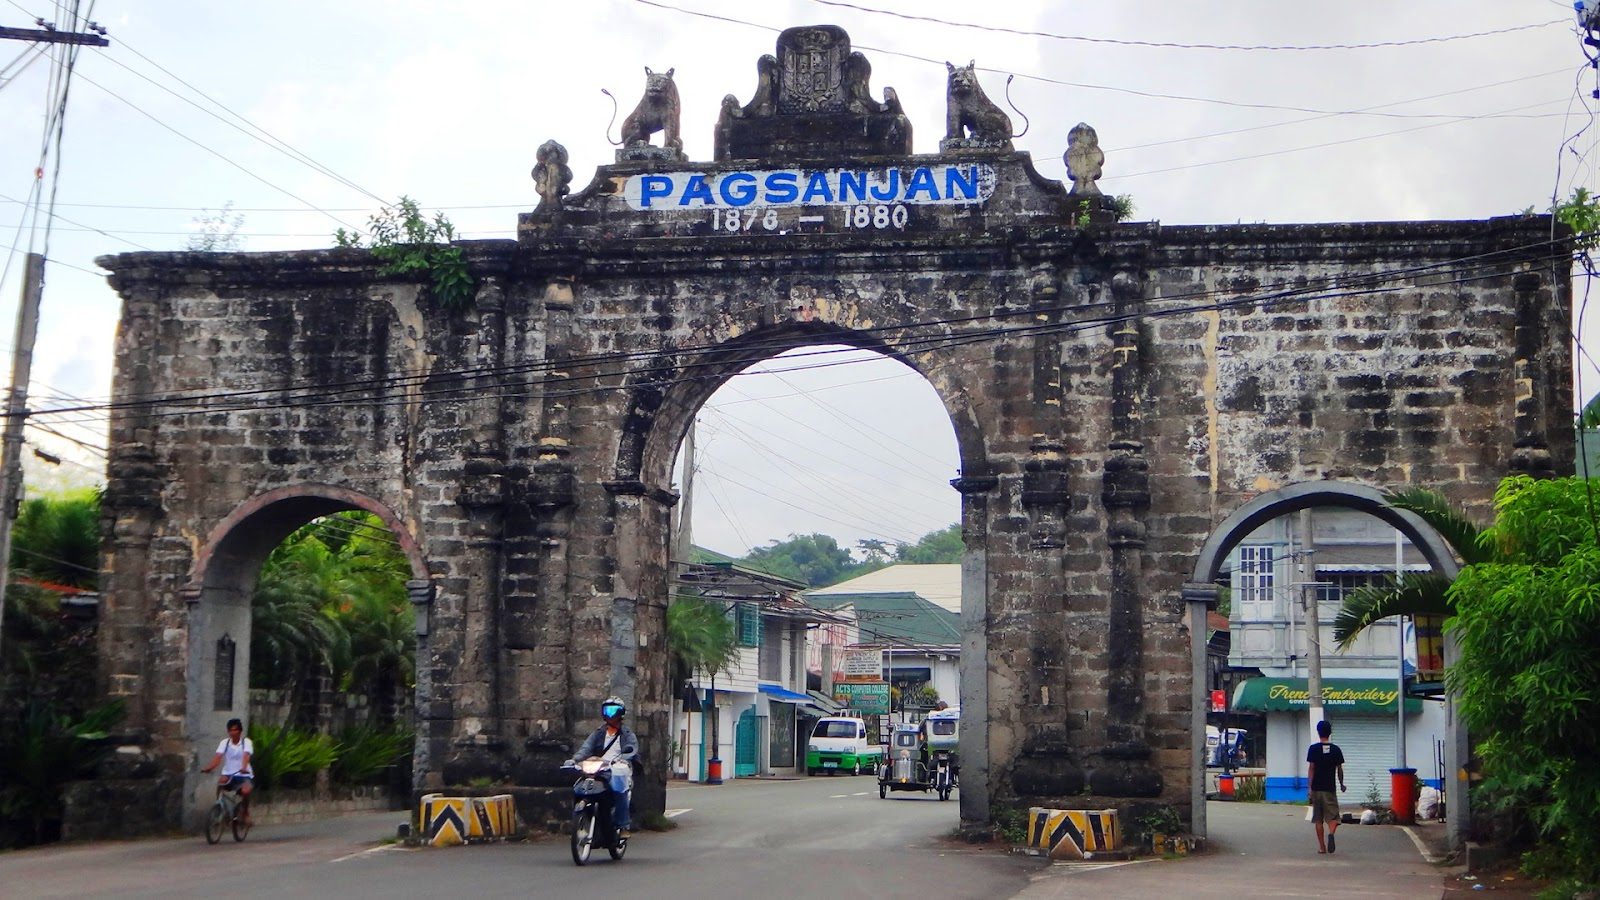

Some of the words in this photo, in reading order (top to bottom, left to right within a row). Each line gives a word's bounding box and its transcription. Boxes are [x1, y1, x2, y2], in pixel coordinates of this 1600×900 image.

[640, 166, 978, 207] PAGSANJAN
[842, 204, 908, 230] 1880
[835, 684, 851, 694] ACTS
[851, 684, 872, 695] COMPUTER
[872, 684, 889, 694] COLLEGE
[1321, 686, 1399, 706] Embroidery
